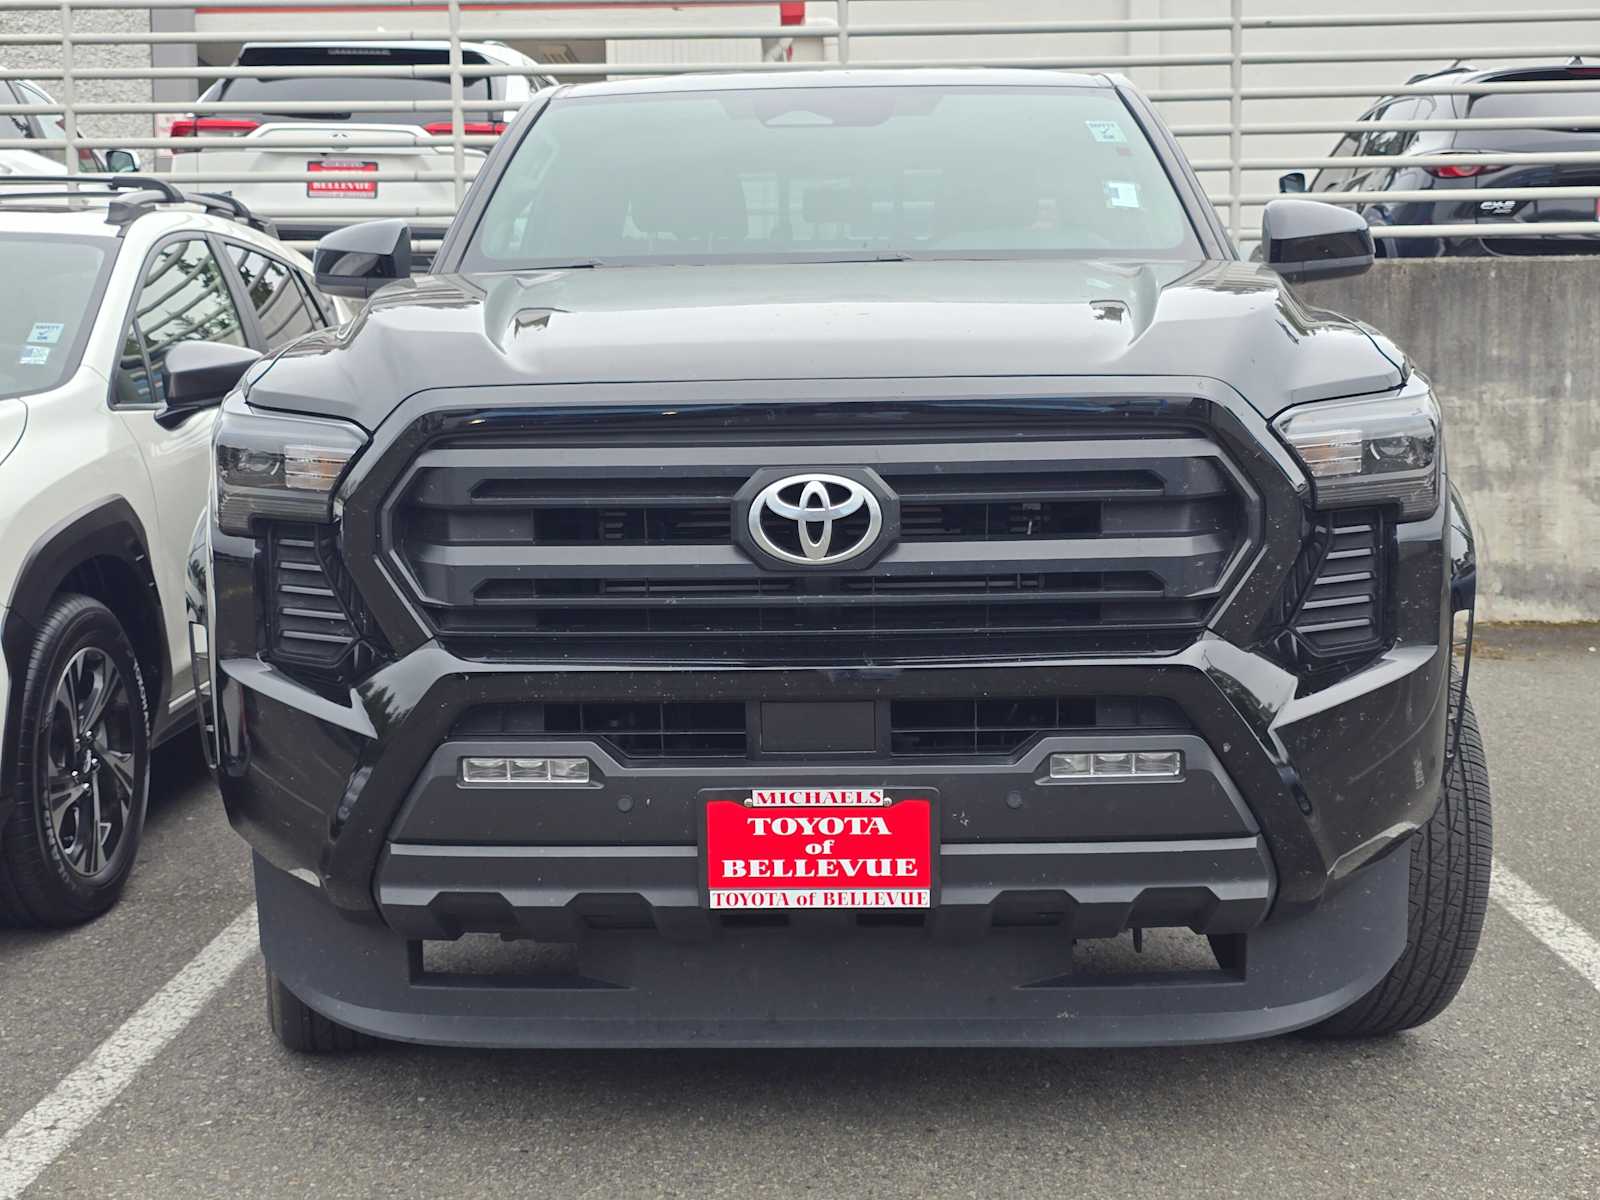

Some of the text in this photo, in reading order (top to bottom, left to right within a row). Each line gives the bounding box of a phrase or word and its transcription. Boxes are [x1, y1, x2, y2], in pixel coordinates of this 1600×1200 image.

[756, 791, 881, 805] MICHAELS
[747, 816, 892, 836] TOYOTA
[805, 839, 835, 855] of
[721, 858, 918, 878] BELLEVUE
[712, 891, 928, 907] TOYOTA of BELLEVUE
